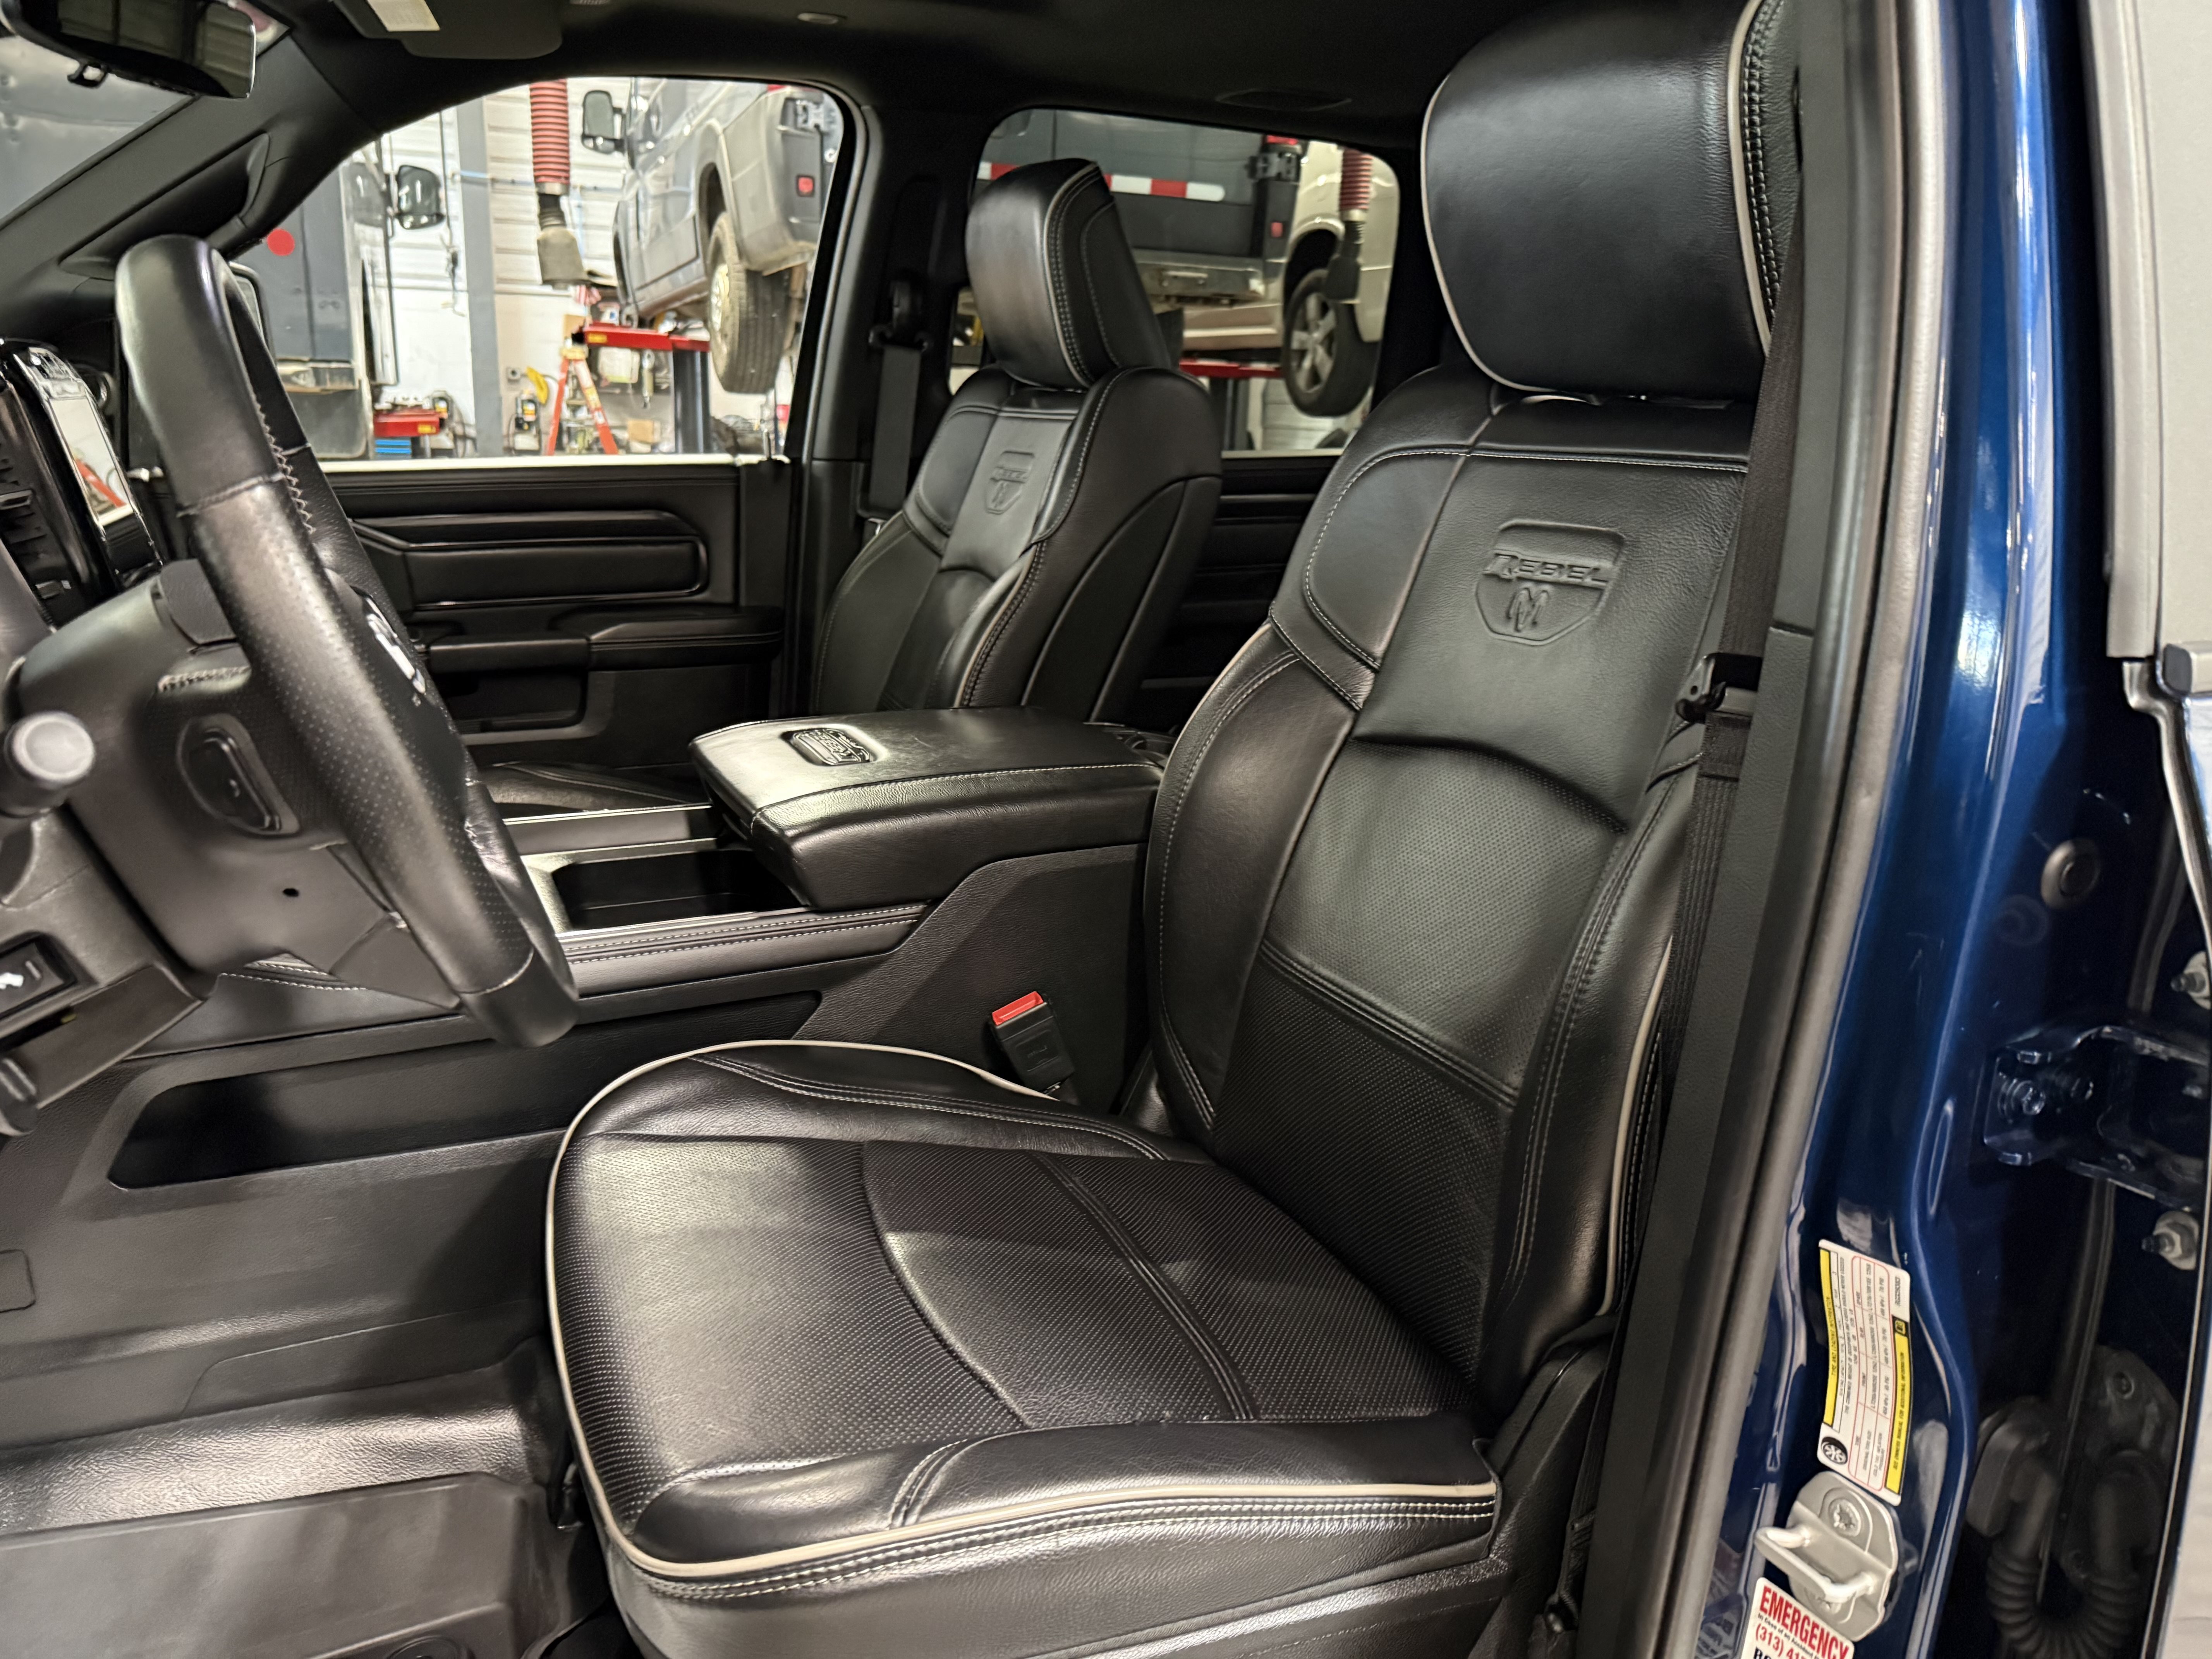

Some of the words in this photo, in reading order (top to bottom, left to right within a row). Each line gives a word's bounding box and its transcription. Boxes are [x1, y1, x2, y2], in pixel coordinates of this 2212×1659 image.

[1483, 552, 1608, 589] REBEL
[1759, 1585, 1849, 1659] EMERGENCY
[1765, 1617, 1777, 1630] Case
[1755, 1623, 1784, 1657] (313)
